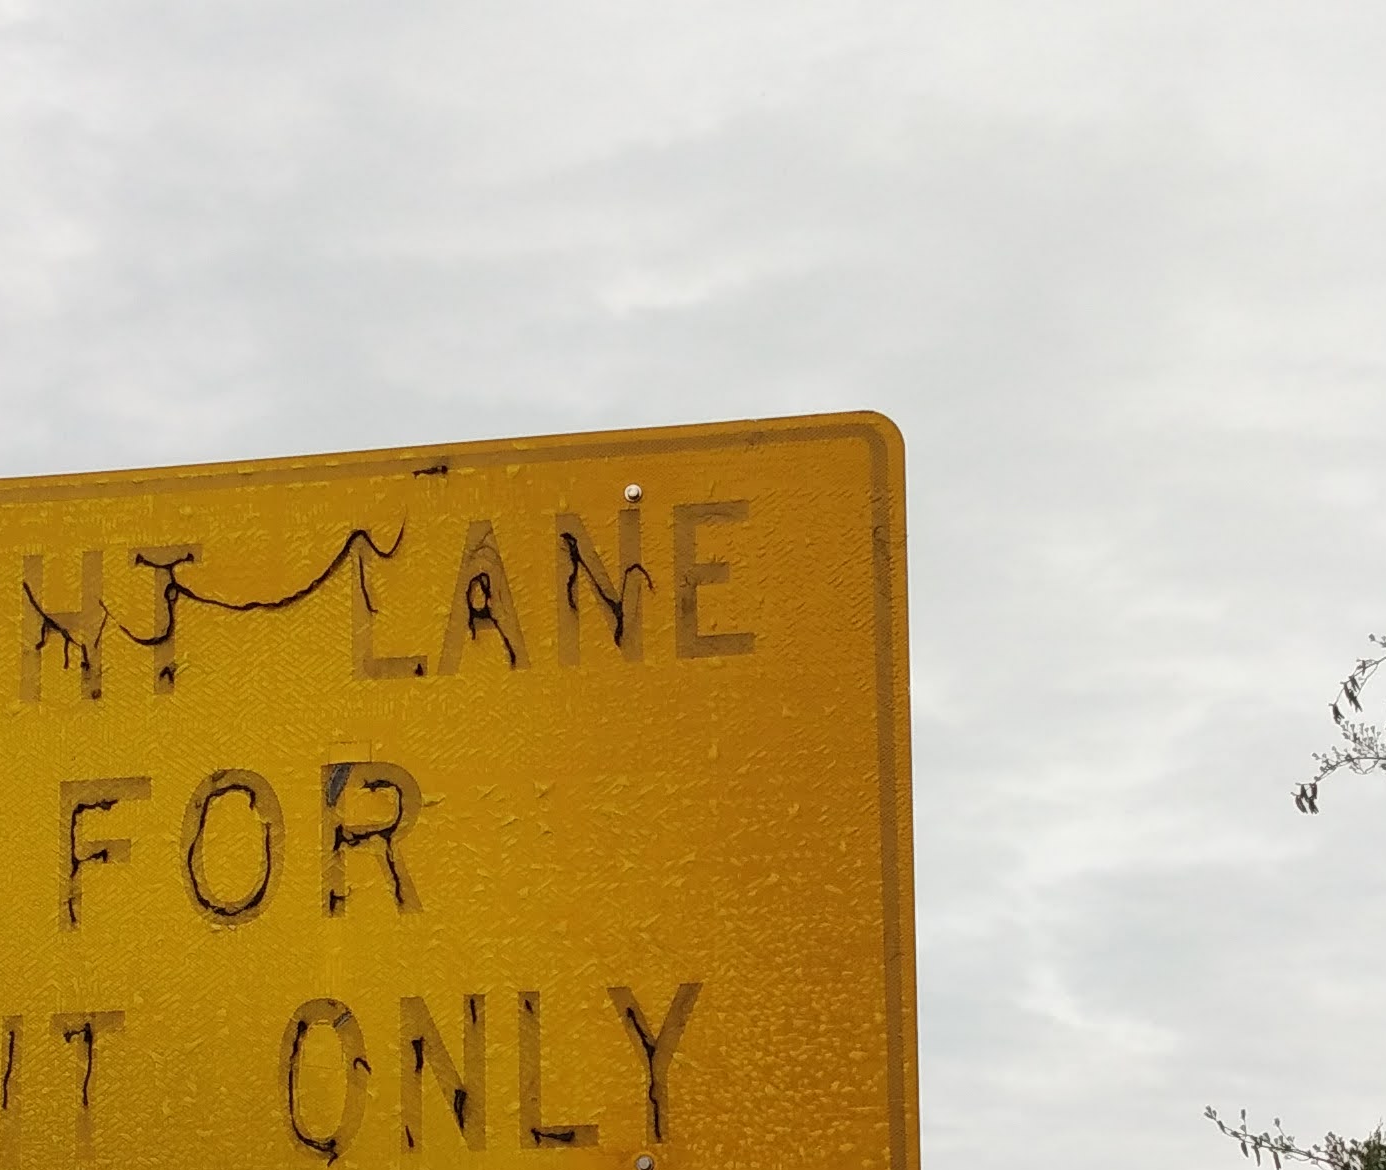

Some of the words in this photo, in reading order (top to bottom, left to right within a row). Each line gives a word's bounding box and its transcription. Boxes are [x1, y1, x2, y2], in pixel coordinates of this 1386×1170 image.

[351, 500, 755, 680] LANE
[60, 761, 425, 932] FOR
[282, 983, 703, 1165] ONLY
